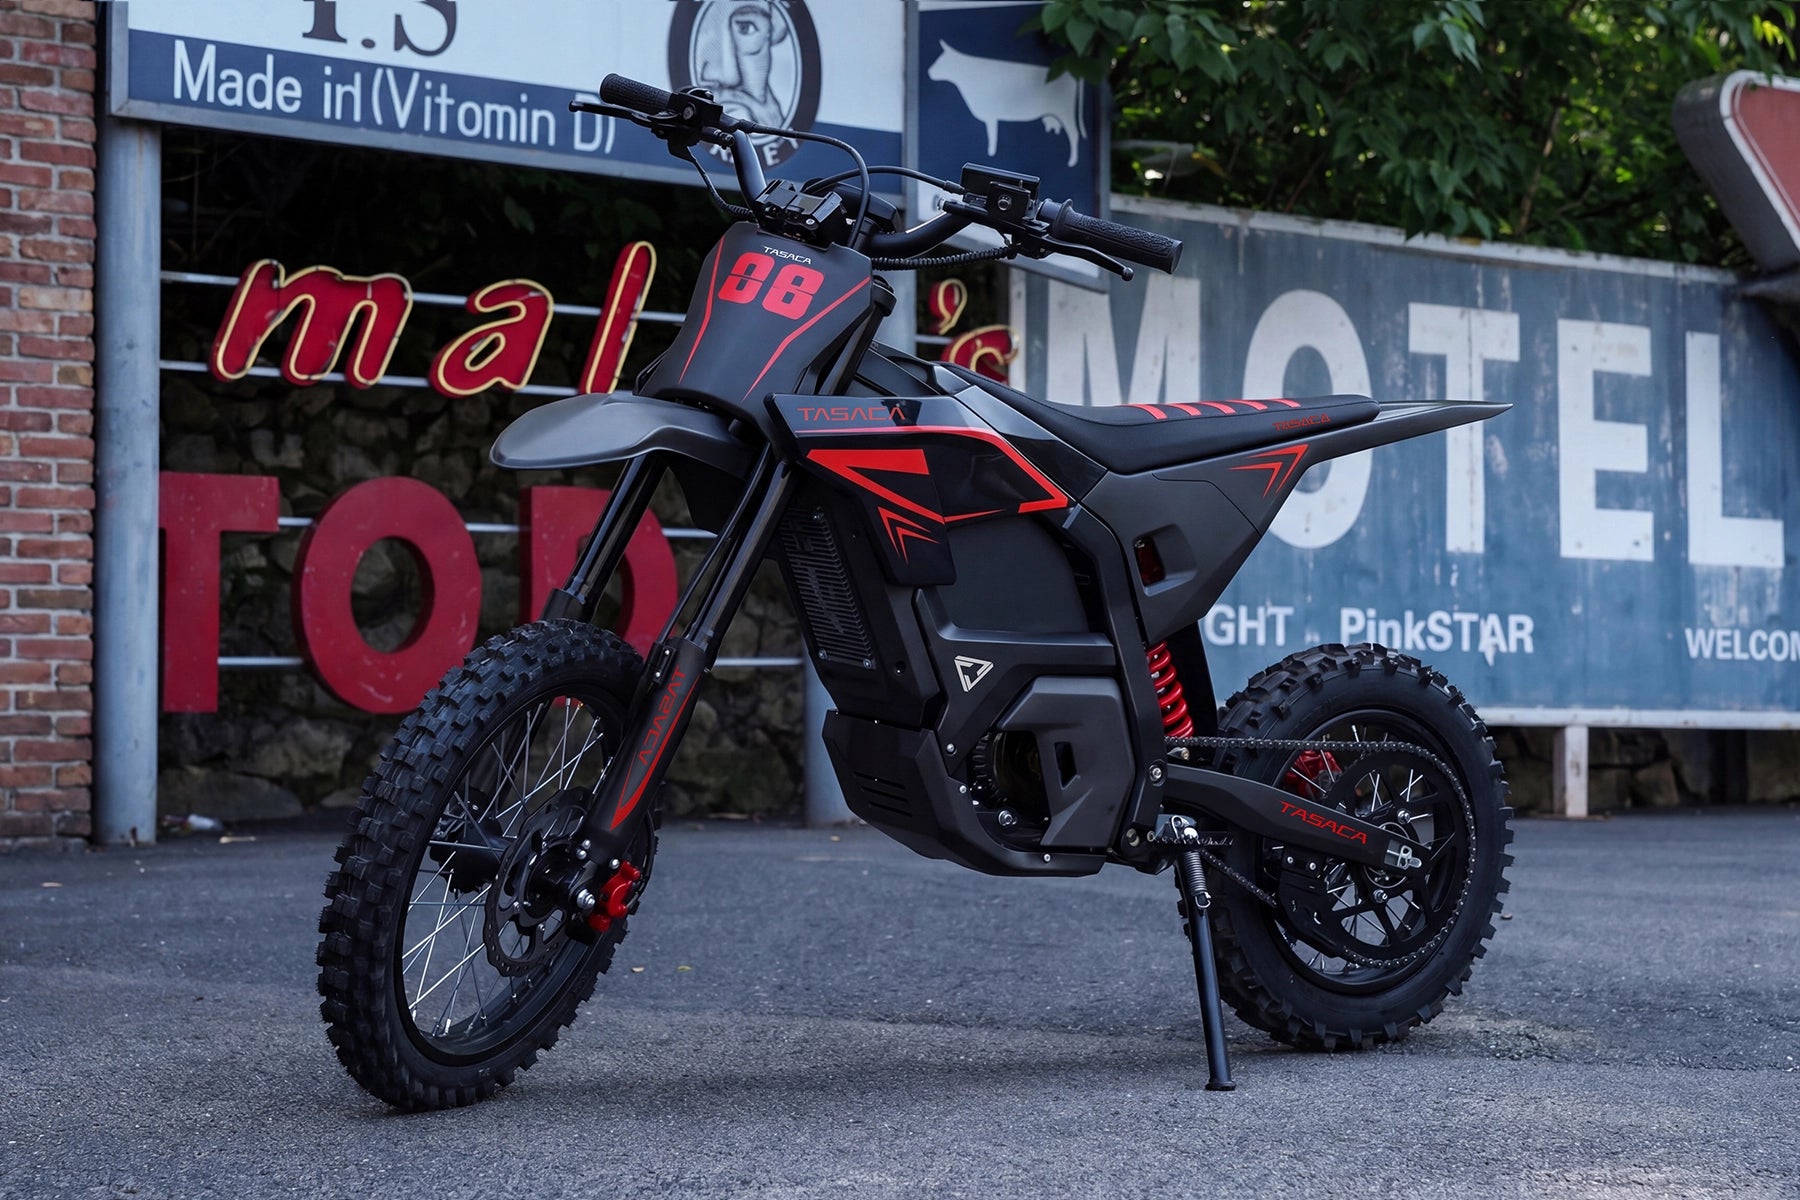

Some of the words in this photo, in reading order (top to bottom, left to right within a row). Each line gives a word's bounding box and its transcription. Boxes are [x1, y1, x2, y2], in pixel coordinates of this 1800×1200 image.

[173, 39, 303, 113] Made
[763, 246, 812, 264] TASACA
[797, 407, 906, 421] TASACA
[1272, 413, 1331, 431] TASACA
[1340, 608, 1534, 654] PinkSTAR
[1281, 801, 1367, 844] TASACA
